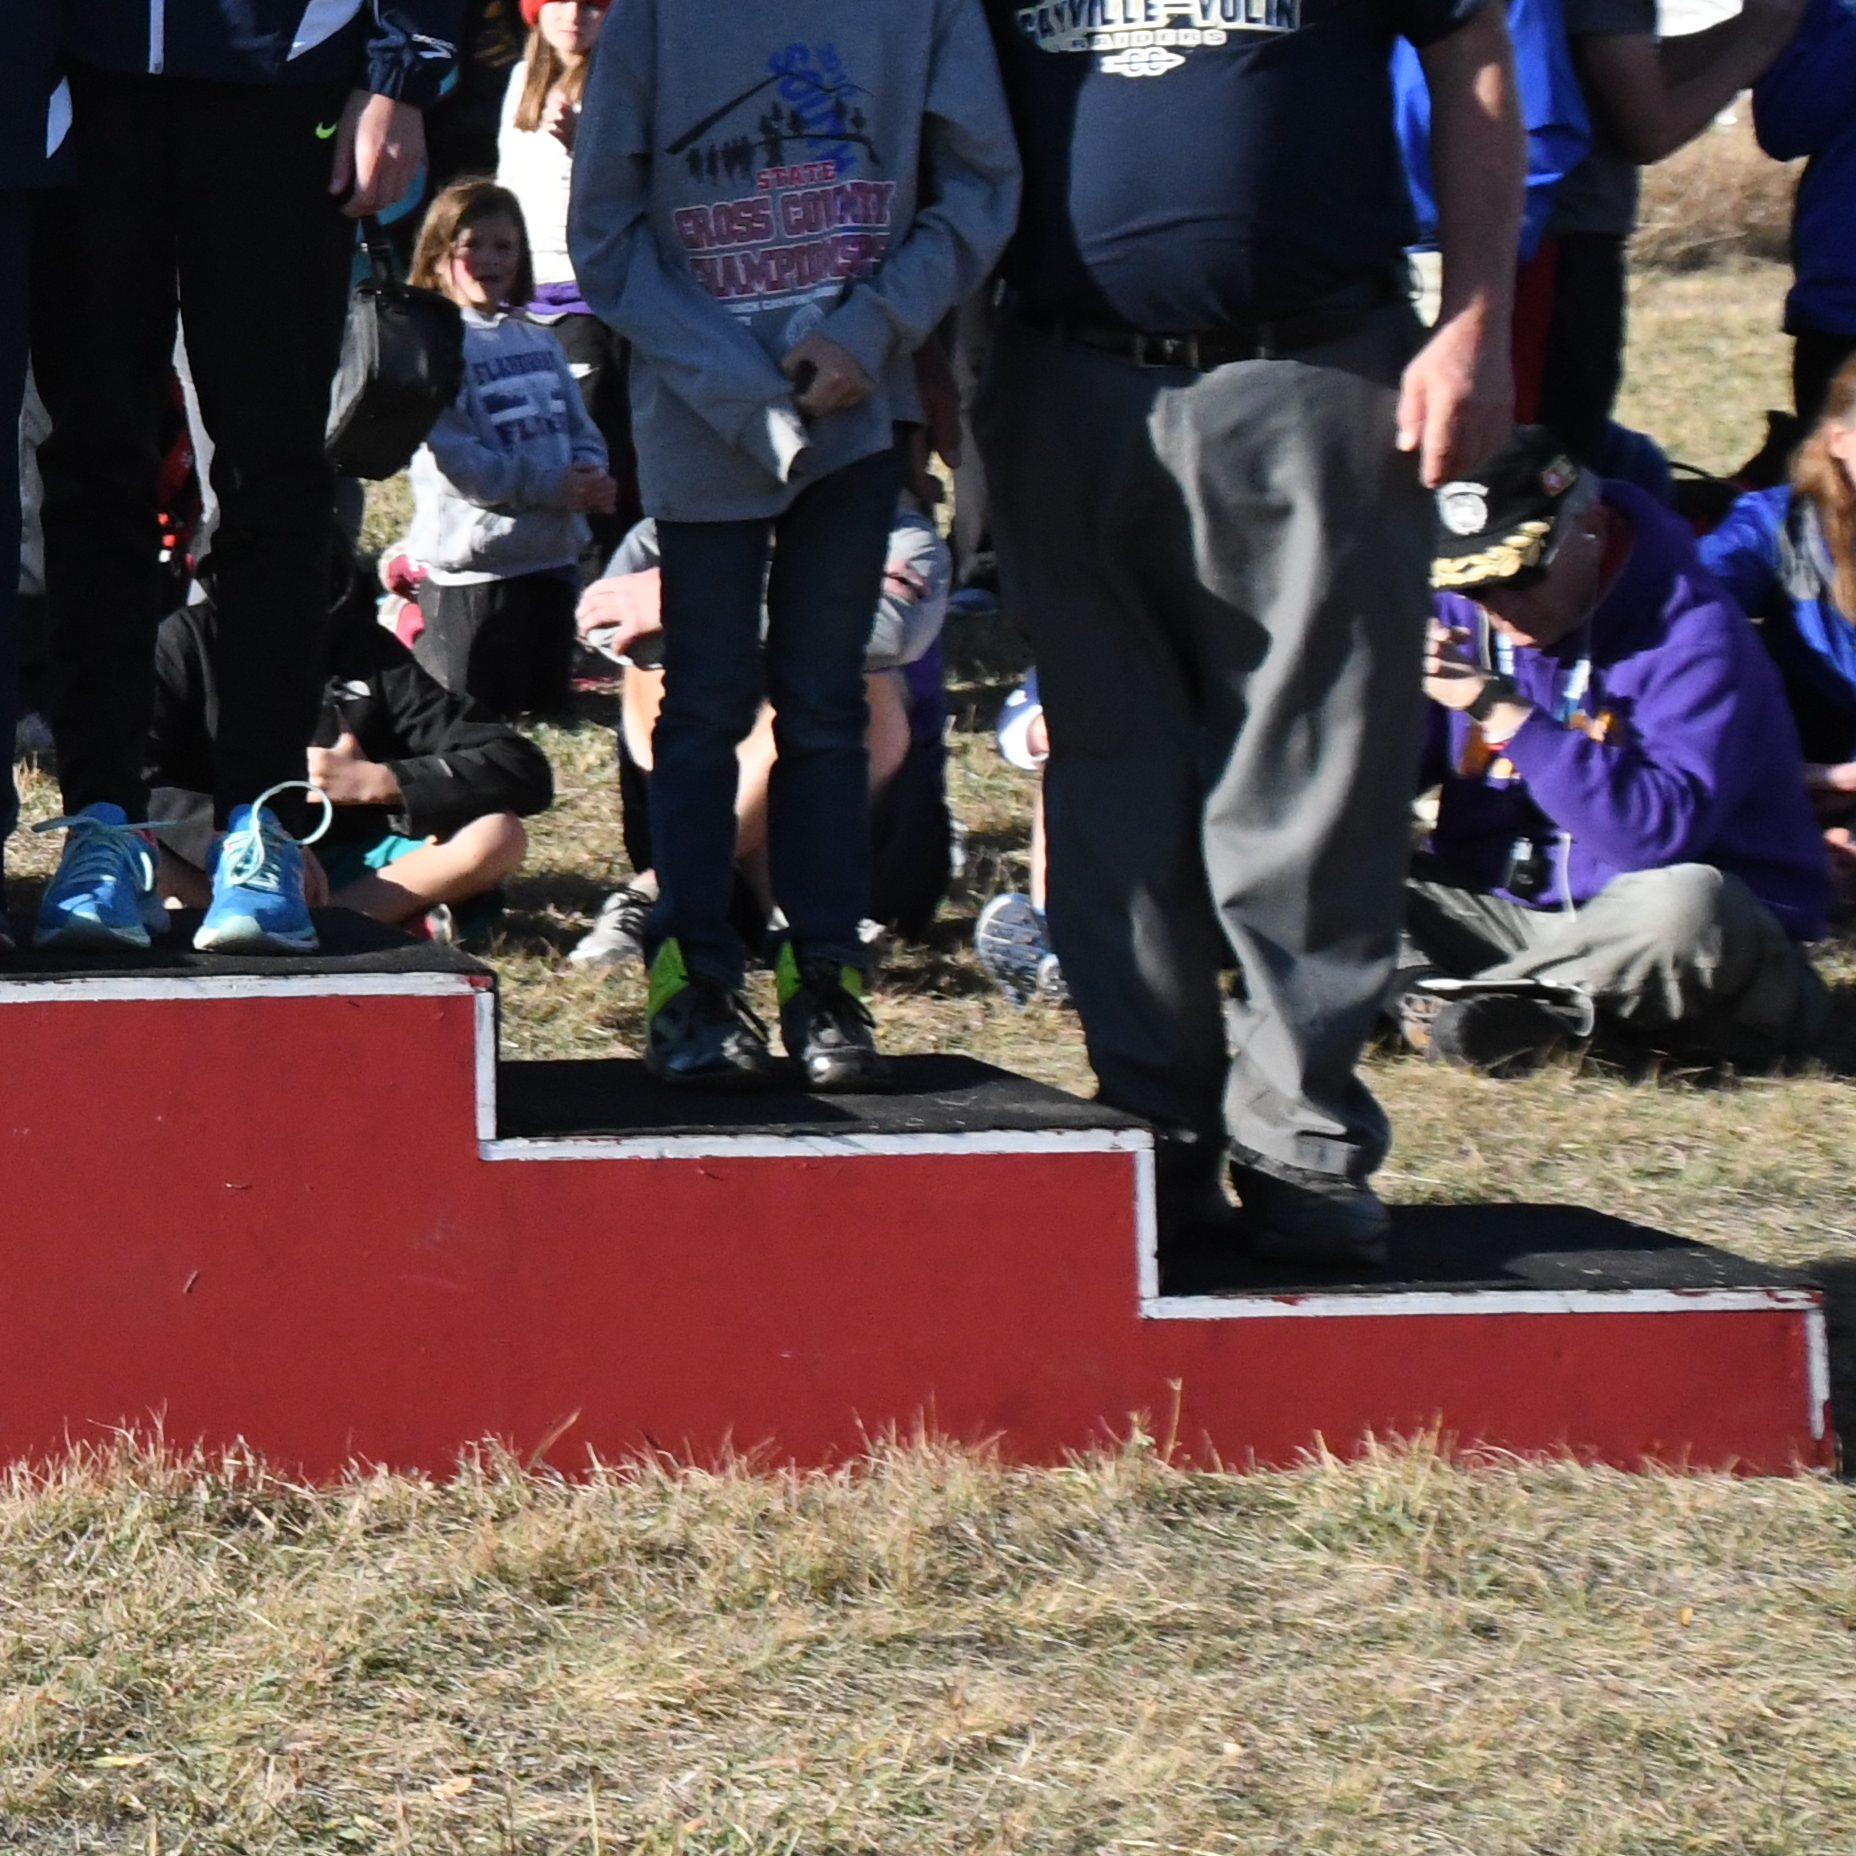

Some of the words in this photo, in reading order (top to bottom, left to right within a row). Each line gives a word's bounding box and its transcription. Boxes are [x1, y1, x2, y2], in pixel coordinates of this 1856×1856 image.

[1072, 30, 1226, 48] RAIDERS
[756, 160, 838, 192] STATE
[674, 195, 776, 251] CROSS
